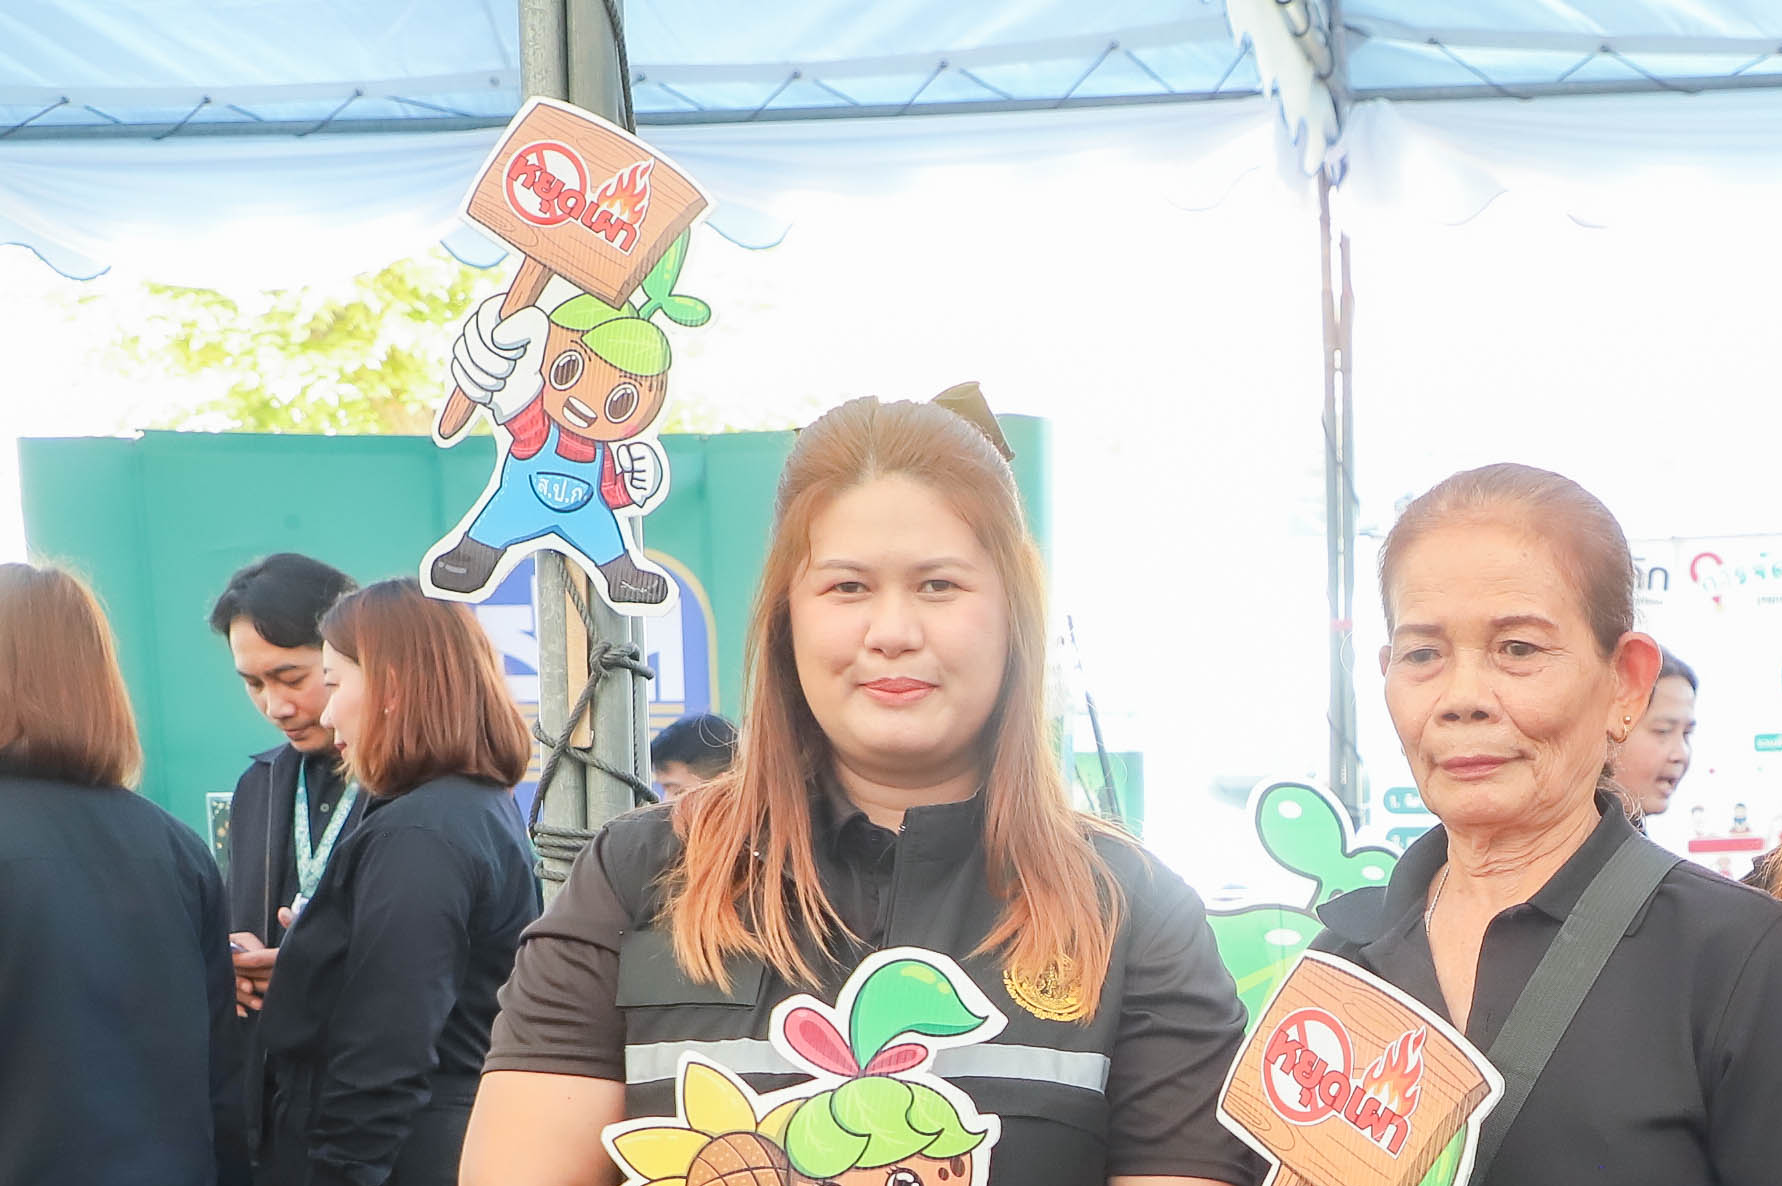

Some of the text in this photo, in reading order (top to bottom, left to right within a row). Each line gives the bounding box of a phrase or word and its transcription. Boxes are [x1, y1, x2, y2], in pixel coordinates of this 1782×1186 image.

[508, 155, 637, 252] หยุดเผา
[537, 478, 588, 504] ส.ป.ก.
[1265, 1029, 1409, 1153] หยุดเผา
